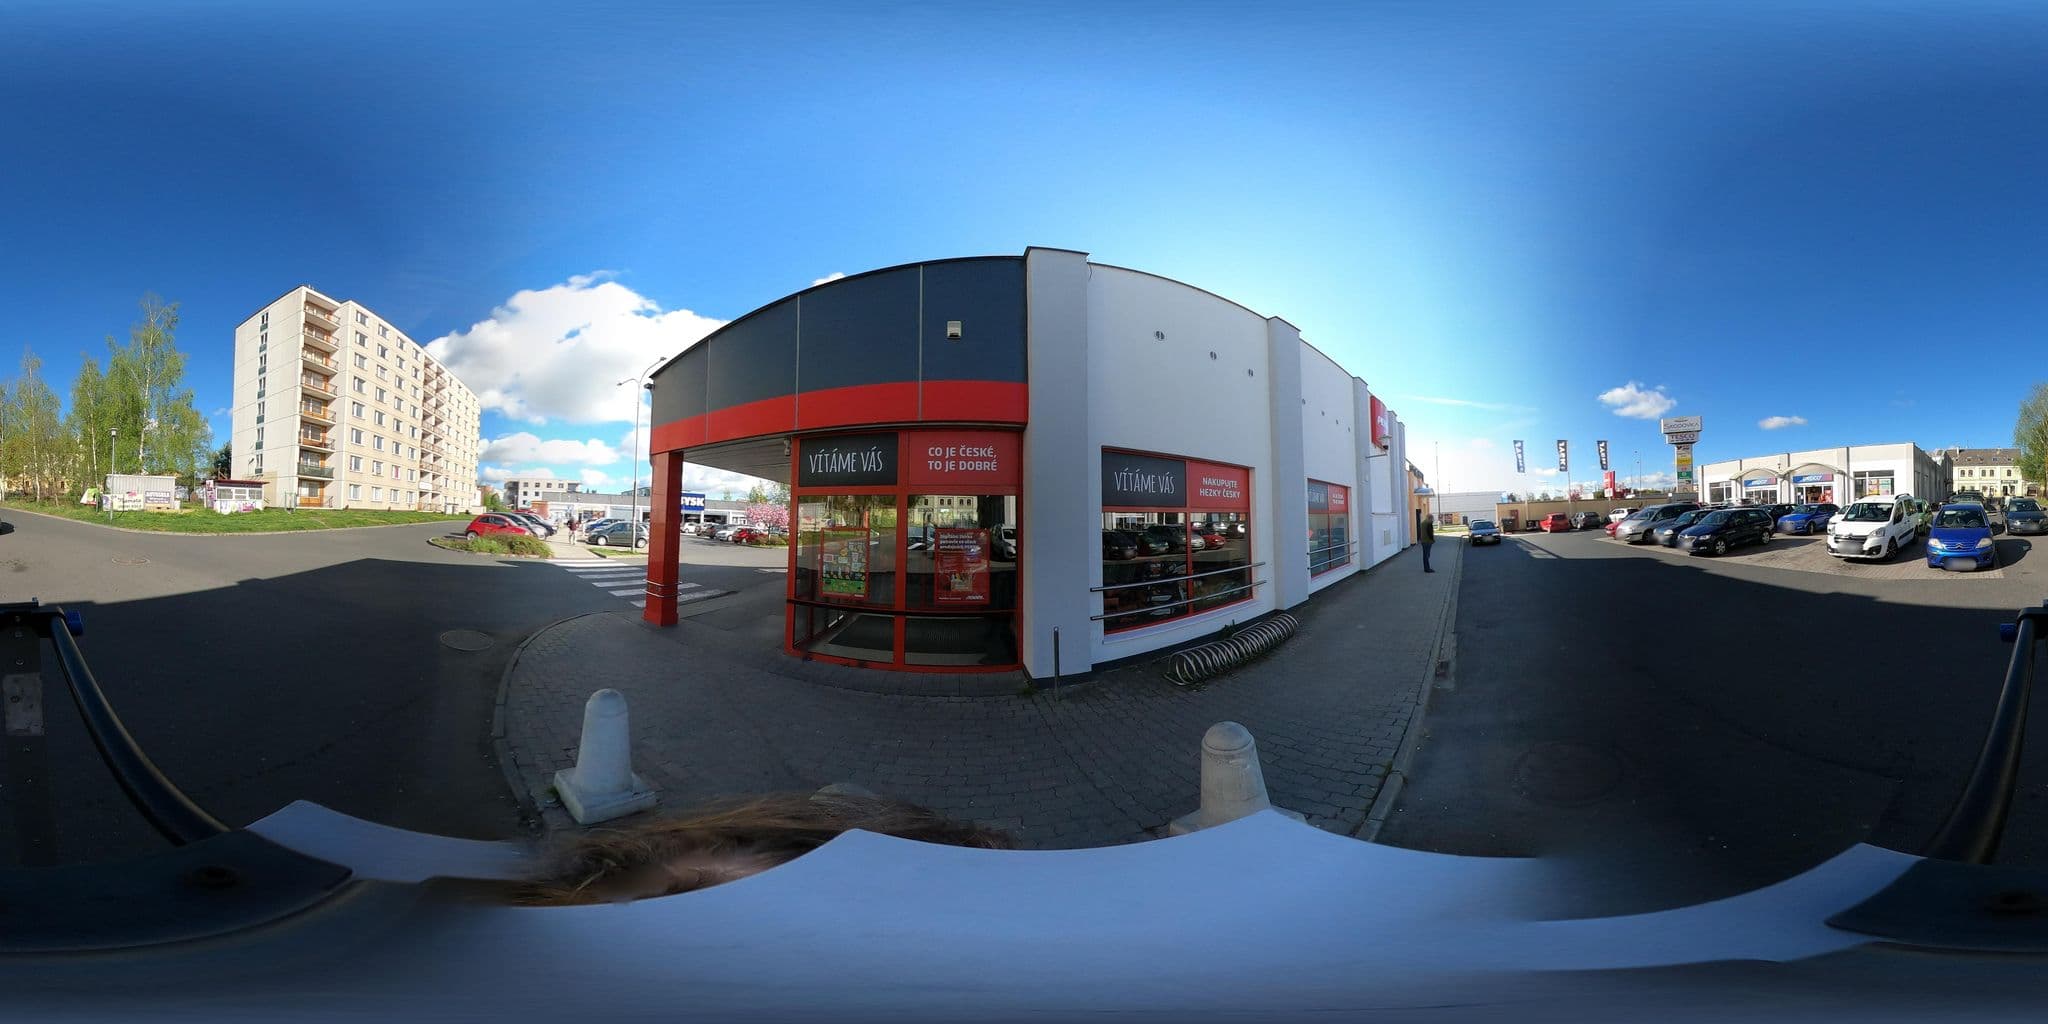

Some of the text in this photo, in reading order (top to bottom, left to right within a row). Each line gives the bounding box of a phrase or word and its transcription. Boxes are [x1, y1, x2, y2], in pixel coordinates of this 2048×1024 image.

[928, 444, 997, 459] CO JE ČESKÉ,
[809, 446, 883, 474] VÍTÁME VÁS
[928, 459, 998, 472] TO JE DOBRÉ
[1114, 467, 1176, 494] VÍTÁME VÁS
[1202, 476, 1238, 489] NAKUPUJTE
[1199, 487, 1241, 499] HEZKY ČESKY
